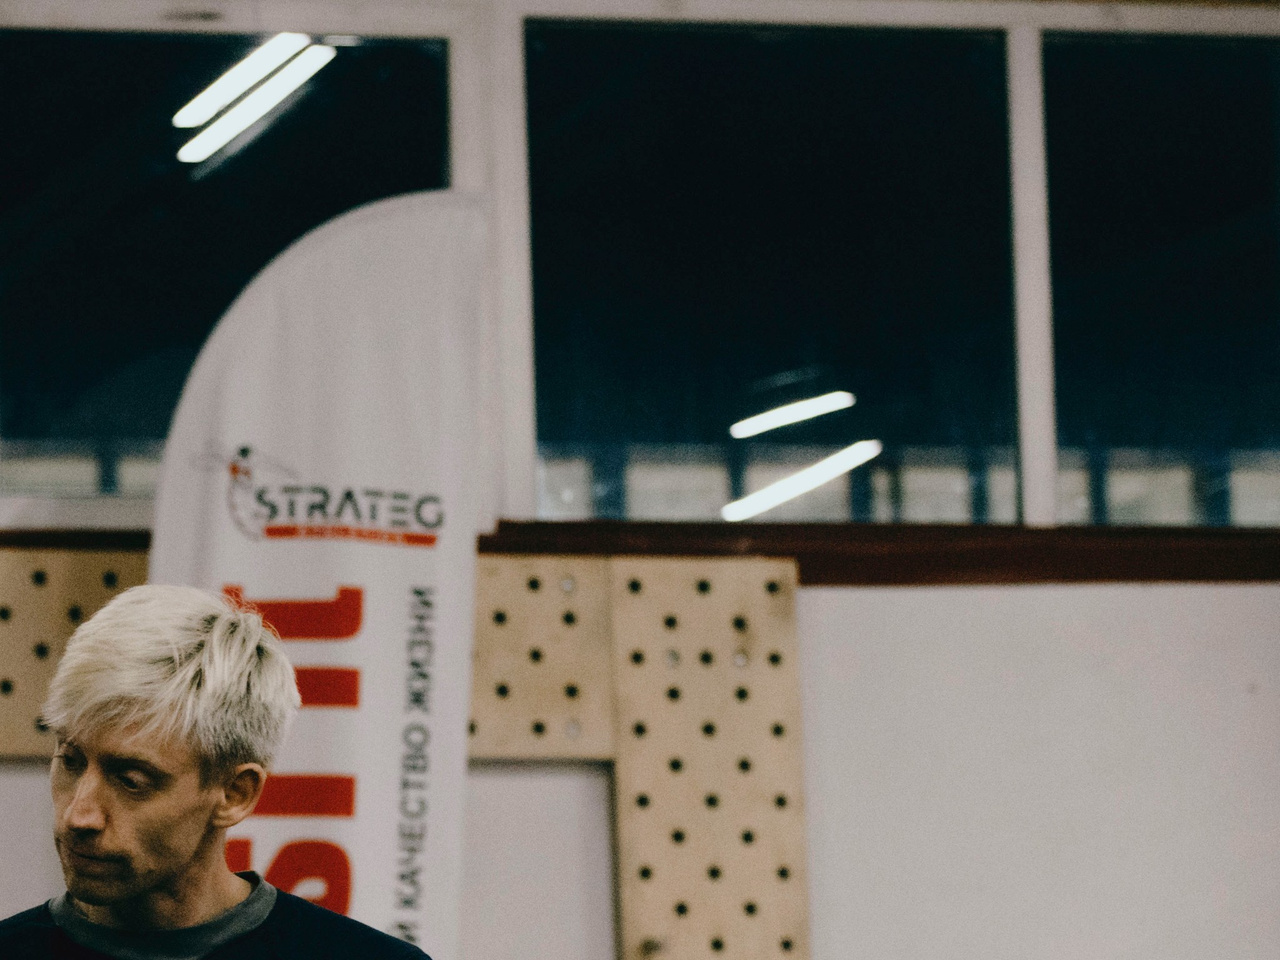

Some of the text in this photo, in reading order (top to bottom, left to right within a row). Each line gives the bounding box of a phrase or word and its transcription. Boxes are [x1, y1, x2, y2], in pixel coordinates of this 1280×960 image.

[254, 485, 444, 529] STRATEG
[404, 586, 434, 714] ЖИЗНИ
[394, 722, 430, 910] КАЧЕСТВО
